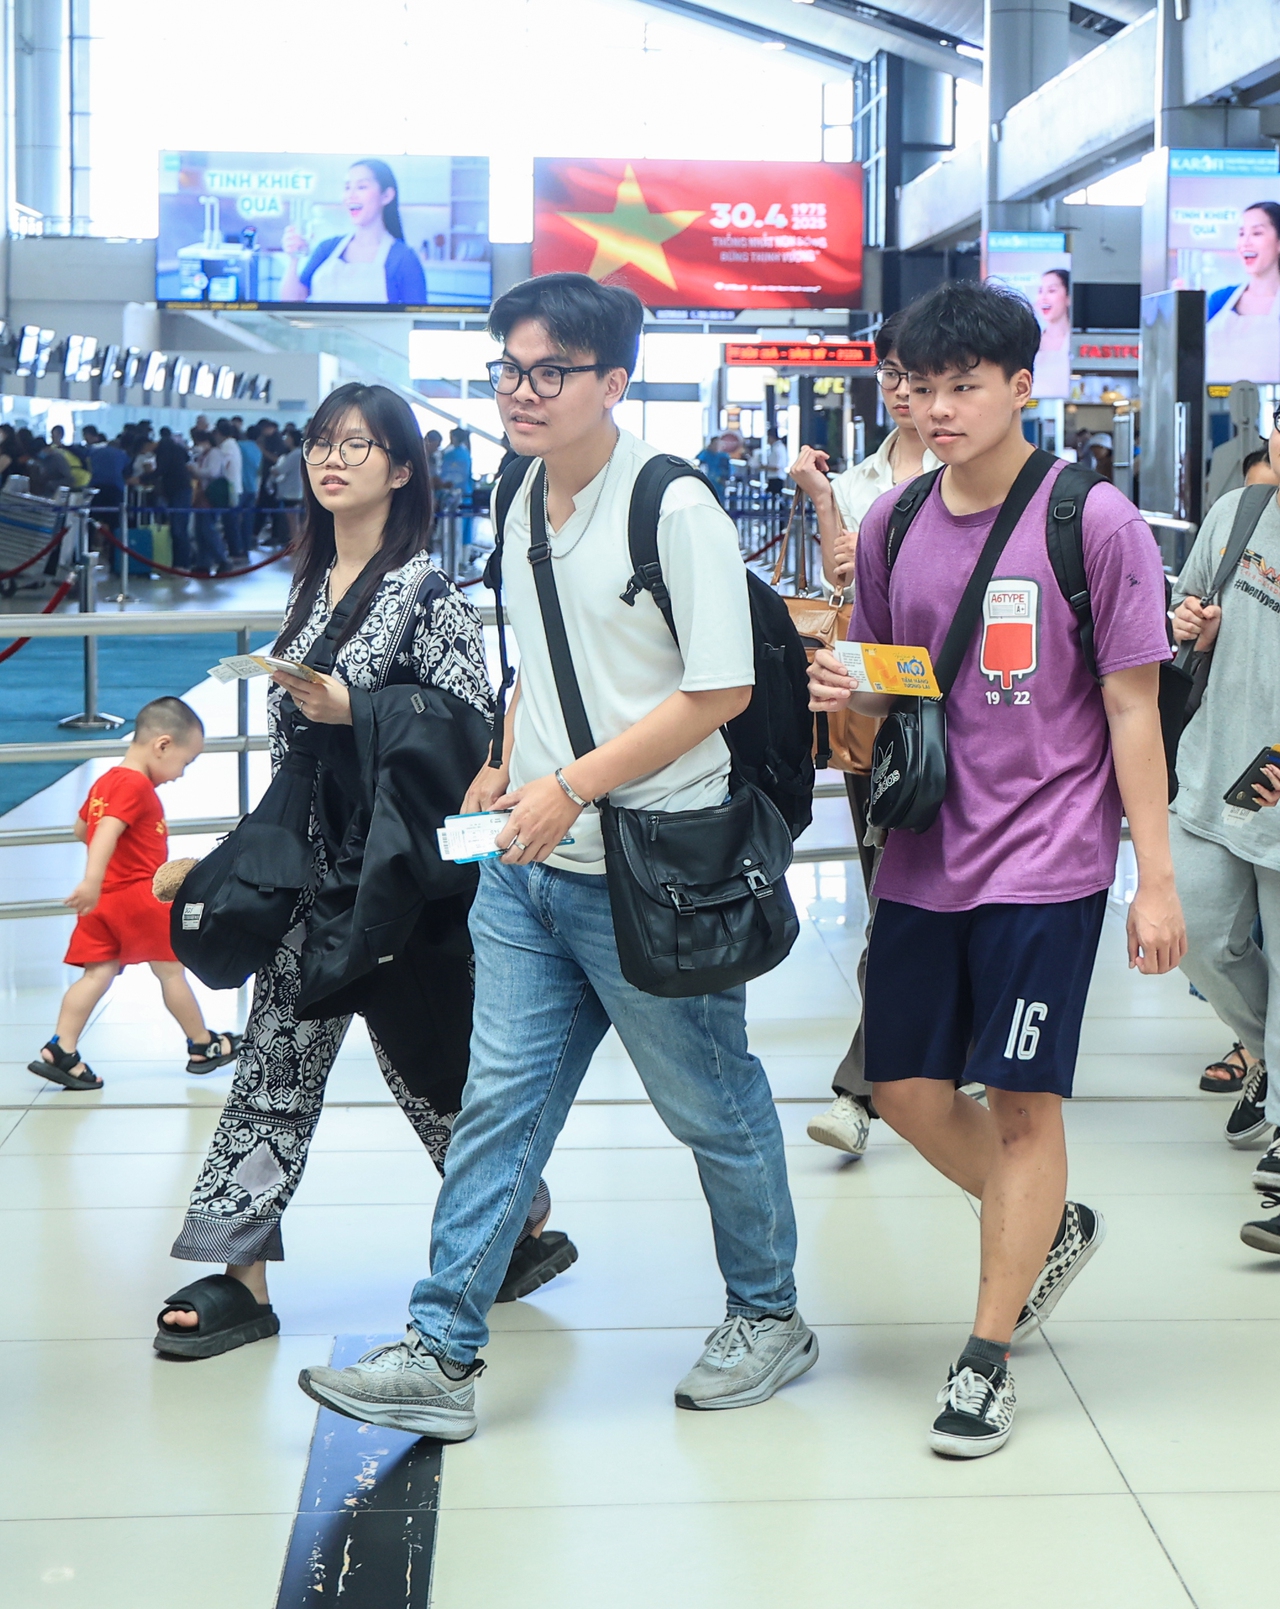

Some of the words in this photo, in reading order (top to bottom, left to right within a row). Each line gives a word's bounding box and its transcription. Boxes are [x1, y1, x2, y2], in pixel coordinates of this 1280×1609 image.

[208, 173, 252, 188] TINH
[241, 194, 279, 214] QUÁ
[709, 202, 788, 229] 30.4
[991, 593, 1025, 603] A6TYPE
[985, 691, 1000, 705] 19
[1013, 691, 1031, 705] 22
[1003, 997, 1049, 1061] 16
